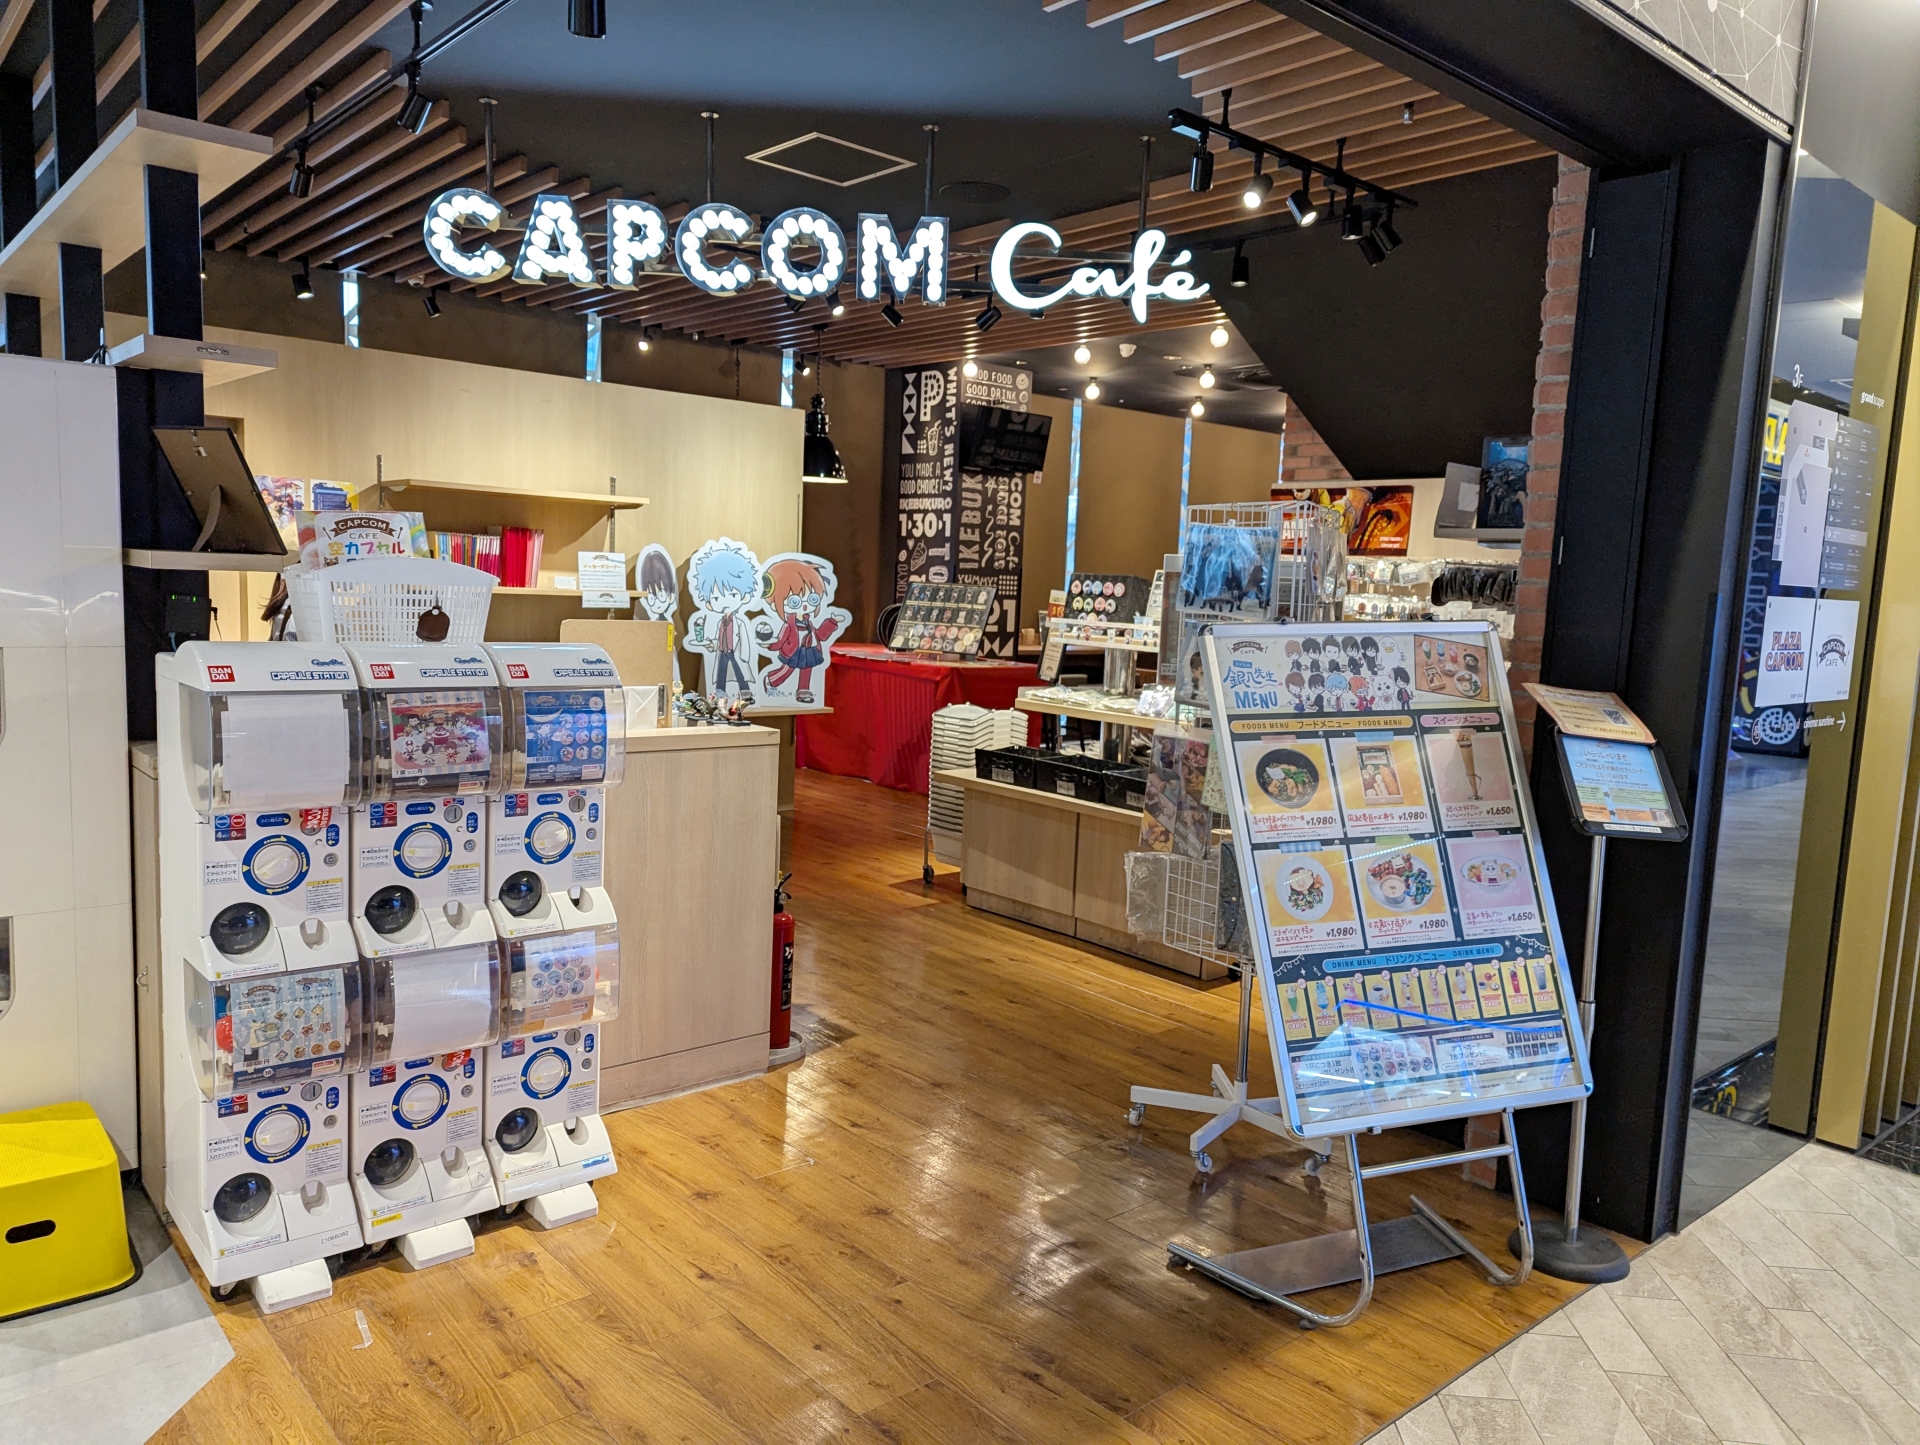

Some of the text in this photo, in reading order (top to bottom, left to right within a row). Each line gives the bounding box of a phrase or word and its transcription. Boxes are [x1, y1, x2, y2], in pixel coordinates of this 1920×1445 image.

[422, 186, 1211, 325] CAPCOM Café
[991, 370, 1012, 387] FOOD
[1792, 363, 1804, 388] 3F
[966, 382, 1017, 401] GOOD DRINK
[1861, 391, 1885, 409] grandscope
[942, 366, 958, 492] WHAT'S NEW?
[901, 461, 941, 478] YOU MADE A
[900, 479, 943, 495] GOOD CHOICE!
[899, 497, 953, 512] IKEBUKURO
[995, 476, 1010, 526] SINCE
[1008, 471, 1024, 528] COM
[338, 519, 387, 531] CAPCOM
[349, 532, 380, 540] CAFE
[327, 540, 406, 557] 空カプセル
[957, 574, 998, 588] YUMMY!
[1235, 641, 1260, 649] CAPCOM
[1771, 631, 1802, 651] PLAZA
[1823, 643, 1844, 655] CAPCOM
[1765, 651, 1805, 672] CAPCOM
[1825, 658, 1838, 667] CAFE
[212, 673, 229, 681] DAI
[270, 671, 349, 681] CAPSULE STATION
[420, 668, 488, 677] CAPSULE STATION
[553, 669, 614, 677] CAPSULE STATION
[1223, 665, 1278, 690] 銀八先生
[1234, 690, 1278, 709] MENU
[1241, 720, 1290, 730] FOODS MENU
[1296, 718, 1350, 729] フードメニュー
[1357, 718, 1403, 727] FOODS MENU
[1432, 714, 1492, 725] スイーツメニュー
[1803, 718, 1818, 730] cinema
[1817, 715, 1835, 728] sunshine
[1398, 811, 1425, 822] ¥1,980
[1486, 805, 1512, 816] ¥1,650
[1305, 815, 1335, 827] ¥1,980
[1507, 911, 1533, 922] ¥1,650
[1419, 918, 1446, 930] ¥1,980
[1326, 926, 1354, 938] ¥1,980
[1452, 946, 1495, 958] DRINK MENU
[1332, 958, 1377, 969] DRINK MENU
[1385, 952, 1447, 965] ドリンクメニュー
[477, 1171, 485, 1180] A
